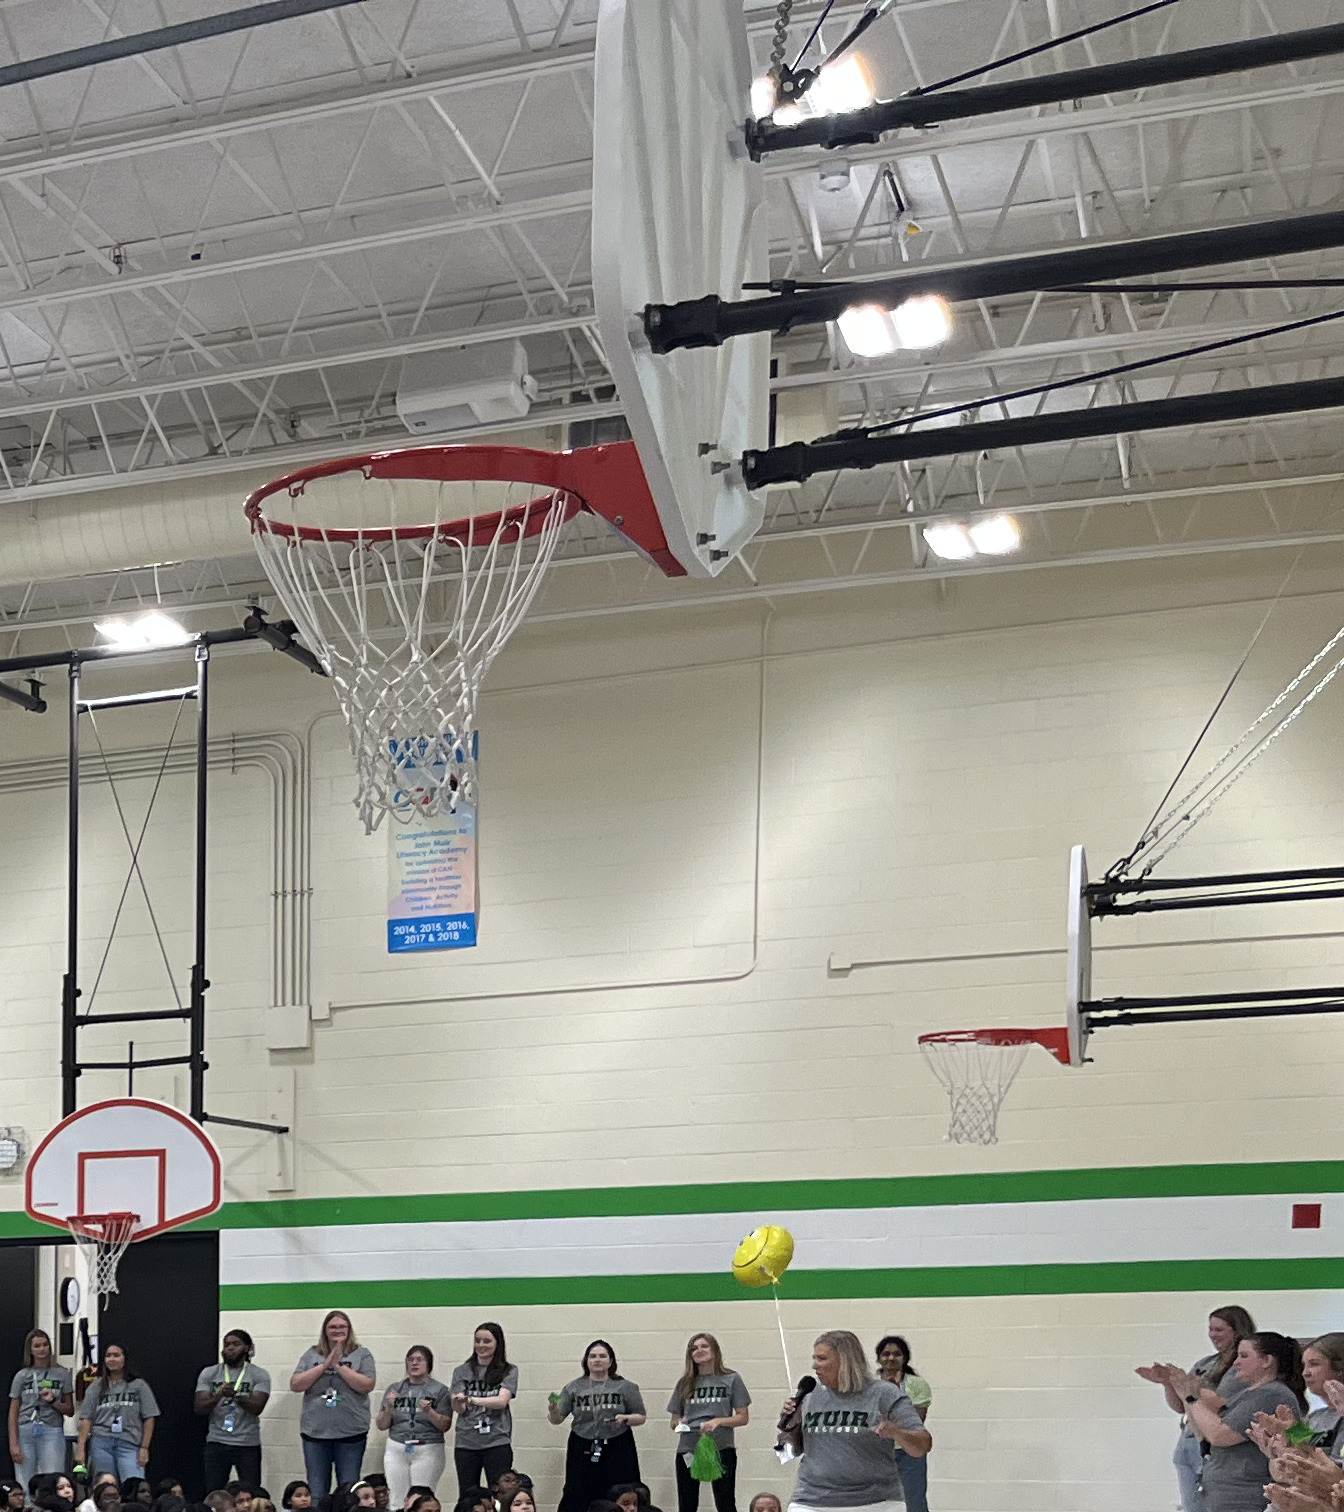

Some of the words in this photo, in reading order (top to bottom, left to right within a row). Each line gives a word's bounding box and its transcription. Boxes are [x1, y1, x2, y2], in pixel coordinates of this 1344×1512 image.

[393, 925, 417, 936] 2014,
[419, 923, 443, 933] 2015,
[446, 920, 470, 931] 2016,
[404, 933, 426, 944] 2017
[437, 931, 460, 941] 2018
[691, 1386, 727, 1399] UIR
[804, 1411, 868, 1428] MUIR
